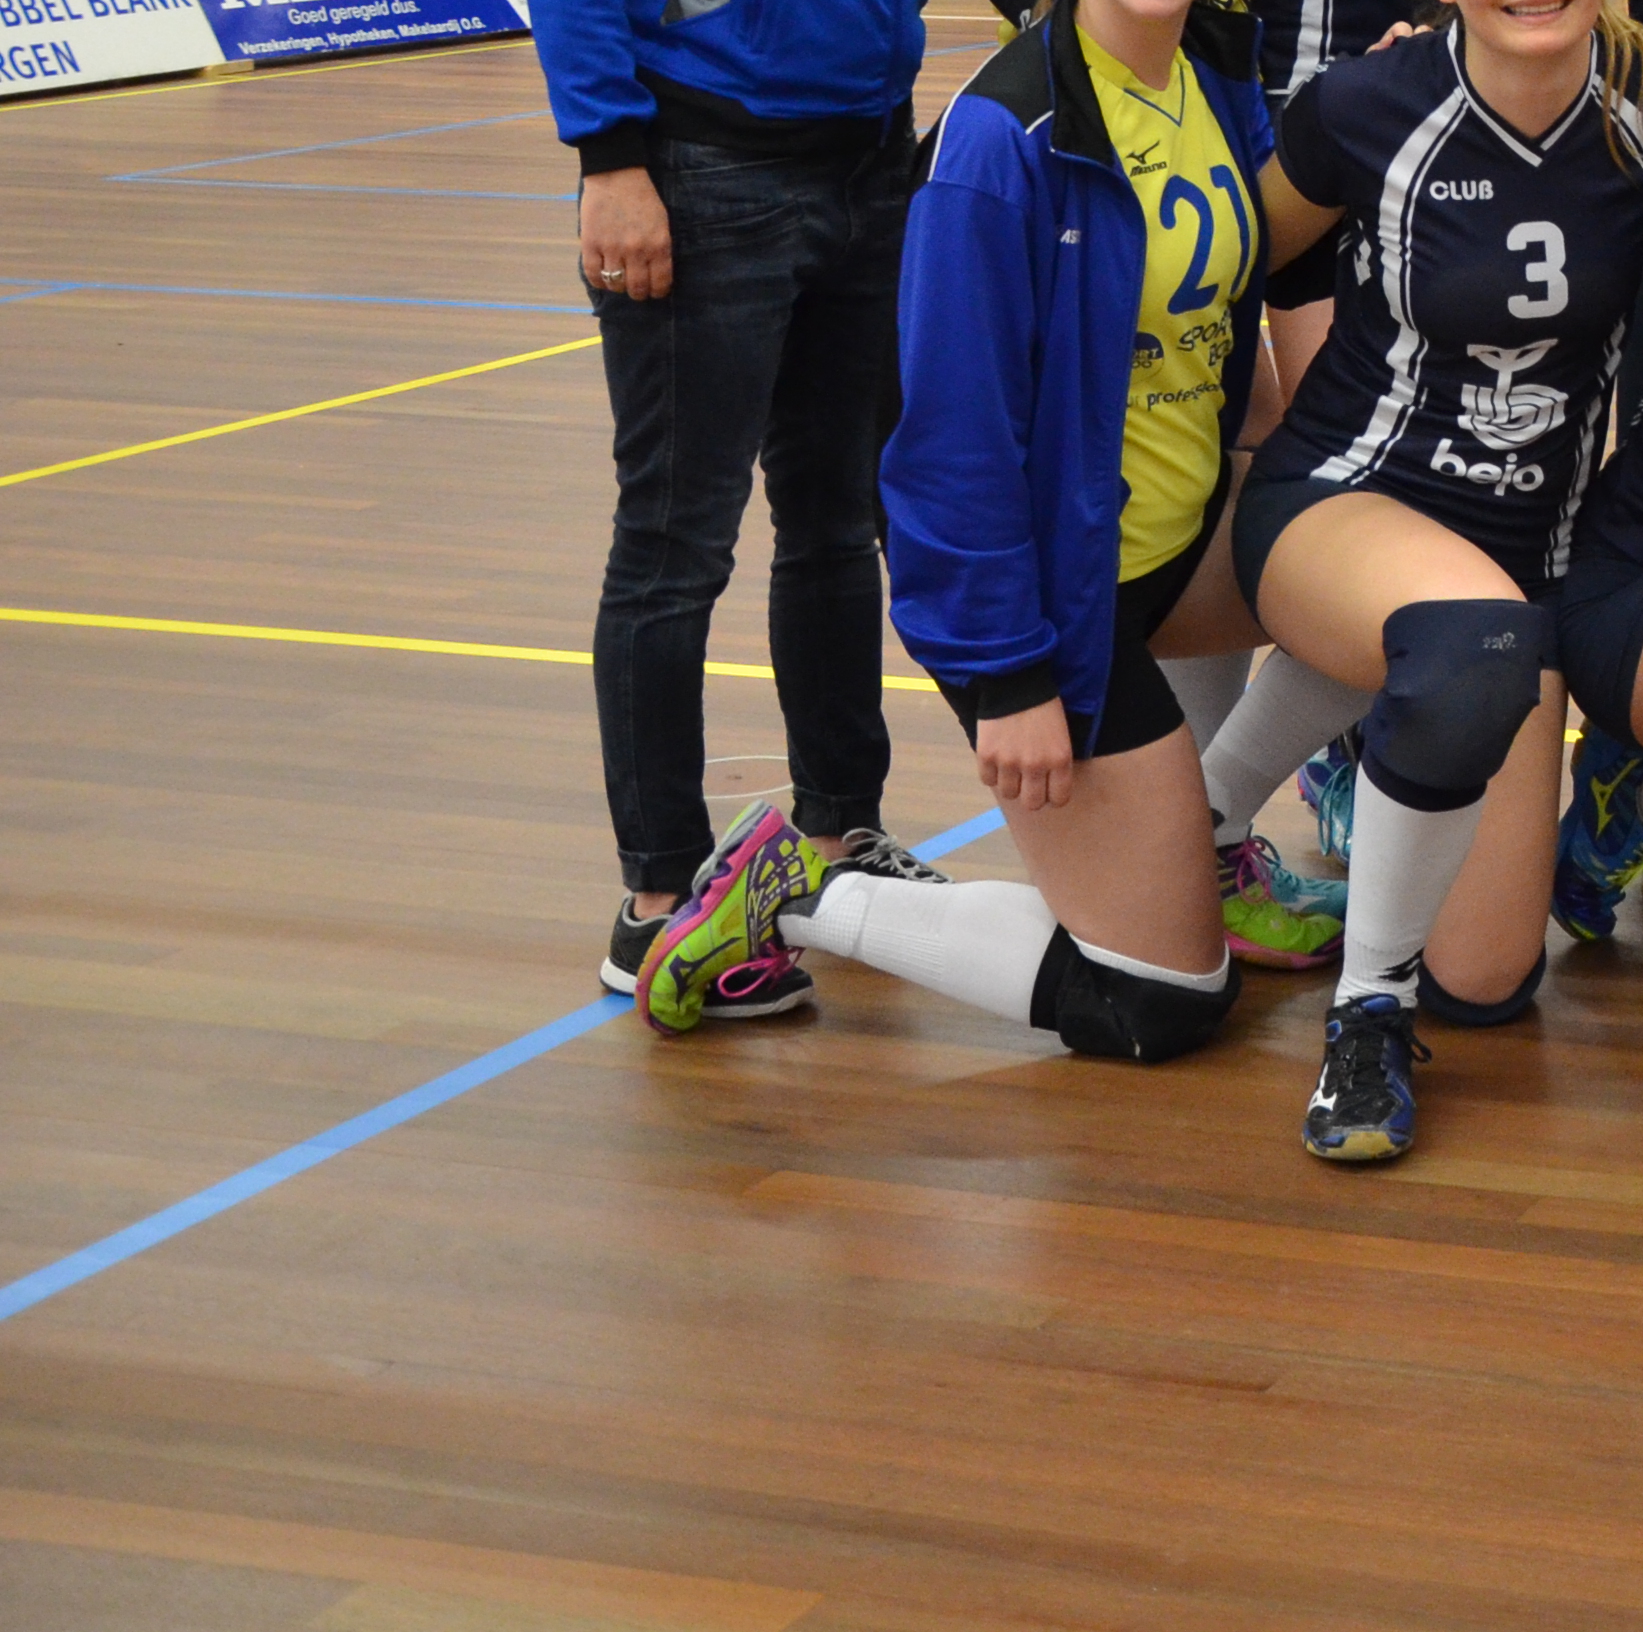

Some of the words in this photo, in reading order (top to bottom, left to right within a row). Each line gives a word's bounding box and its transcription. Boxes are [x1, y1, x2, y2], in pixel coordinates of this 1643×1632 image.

[287, 7, 328, 25] Goed
[330, 0, 389, 23] geregeld
[238, 36, 329, 55] Verzekeringen,
[328, 27, 399, 47] Hypotheken,
[1429, 179, 1494, 201] CLUB
[1159, 164, 1250, 315] 21
[1506, 220, 1569, 319] 3
[1430, 437, 1544, 497] bejo
